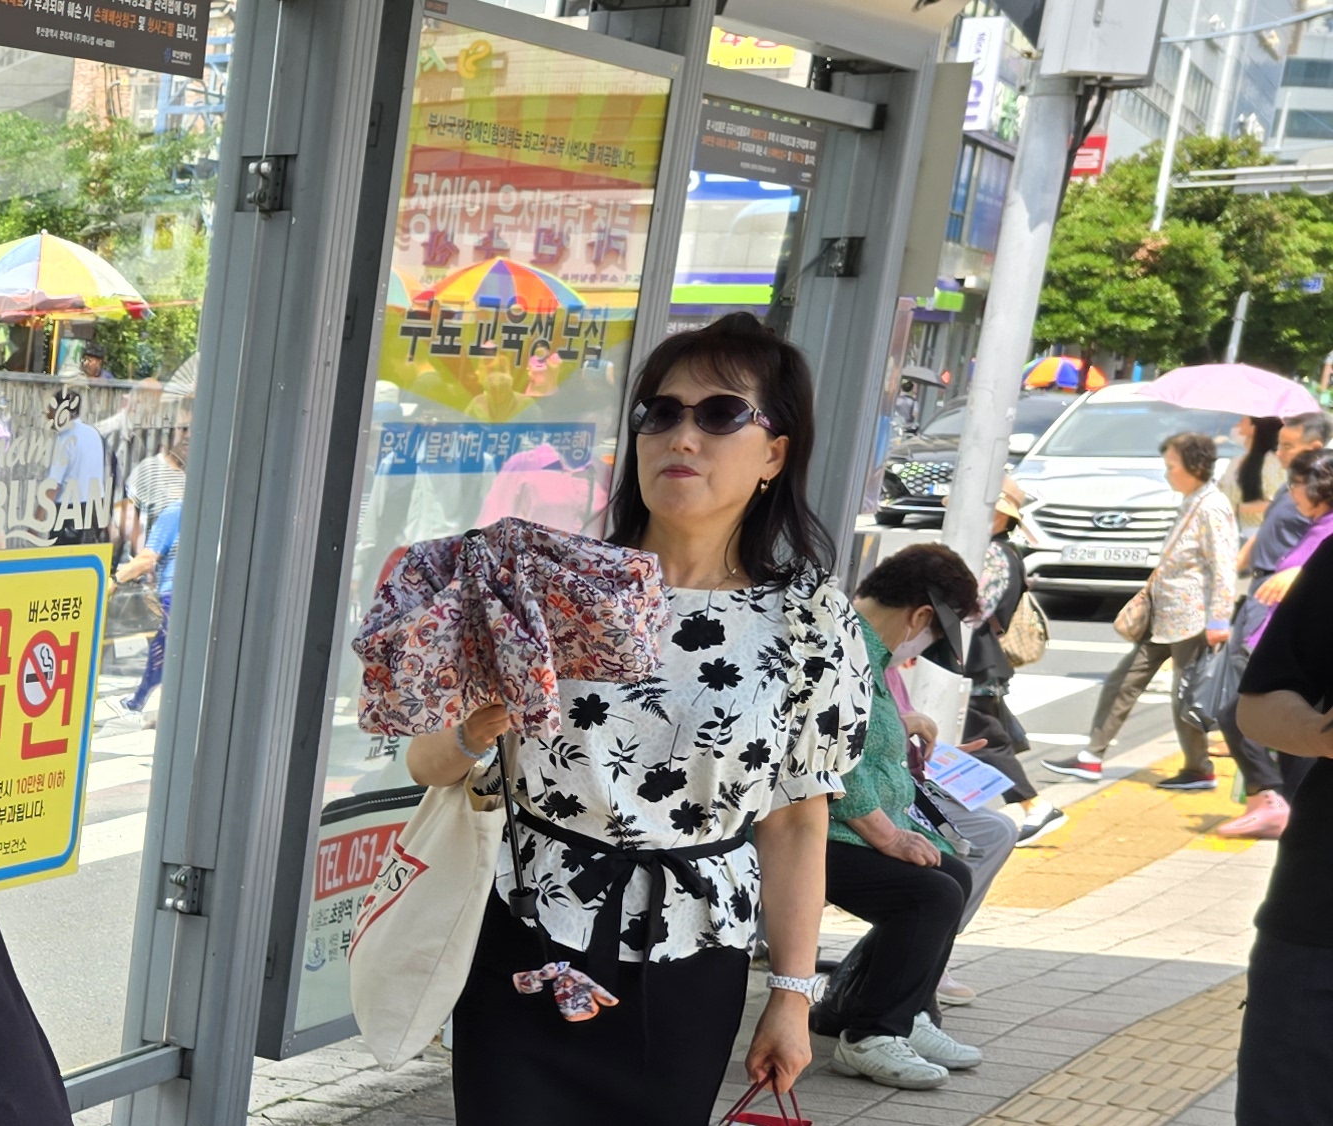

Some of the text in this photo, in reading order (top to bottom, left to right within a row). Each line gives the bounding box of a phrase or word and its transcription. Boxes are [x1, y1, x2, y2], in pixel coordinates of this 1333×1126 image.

[176, 23, 199, 42] 됩니다.
[409, 172, 492, 246] 장애인
[468, 296, 561, 368] 교육생
[28, 596, 83, 623] 버스정류장
[16, 773, 45, 795] 10만원
[47, 770, 65, 790] 이하
[318, 842, 343, 893] TEL.
